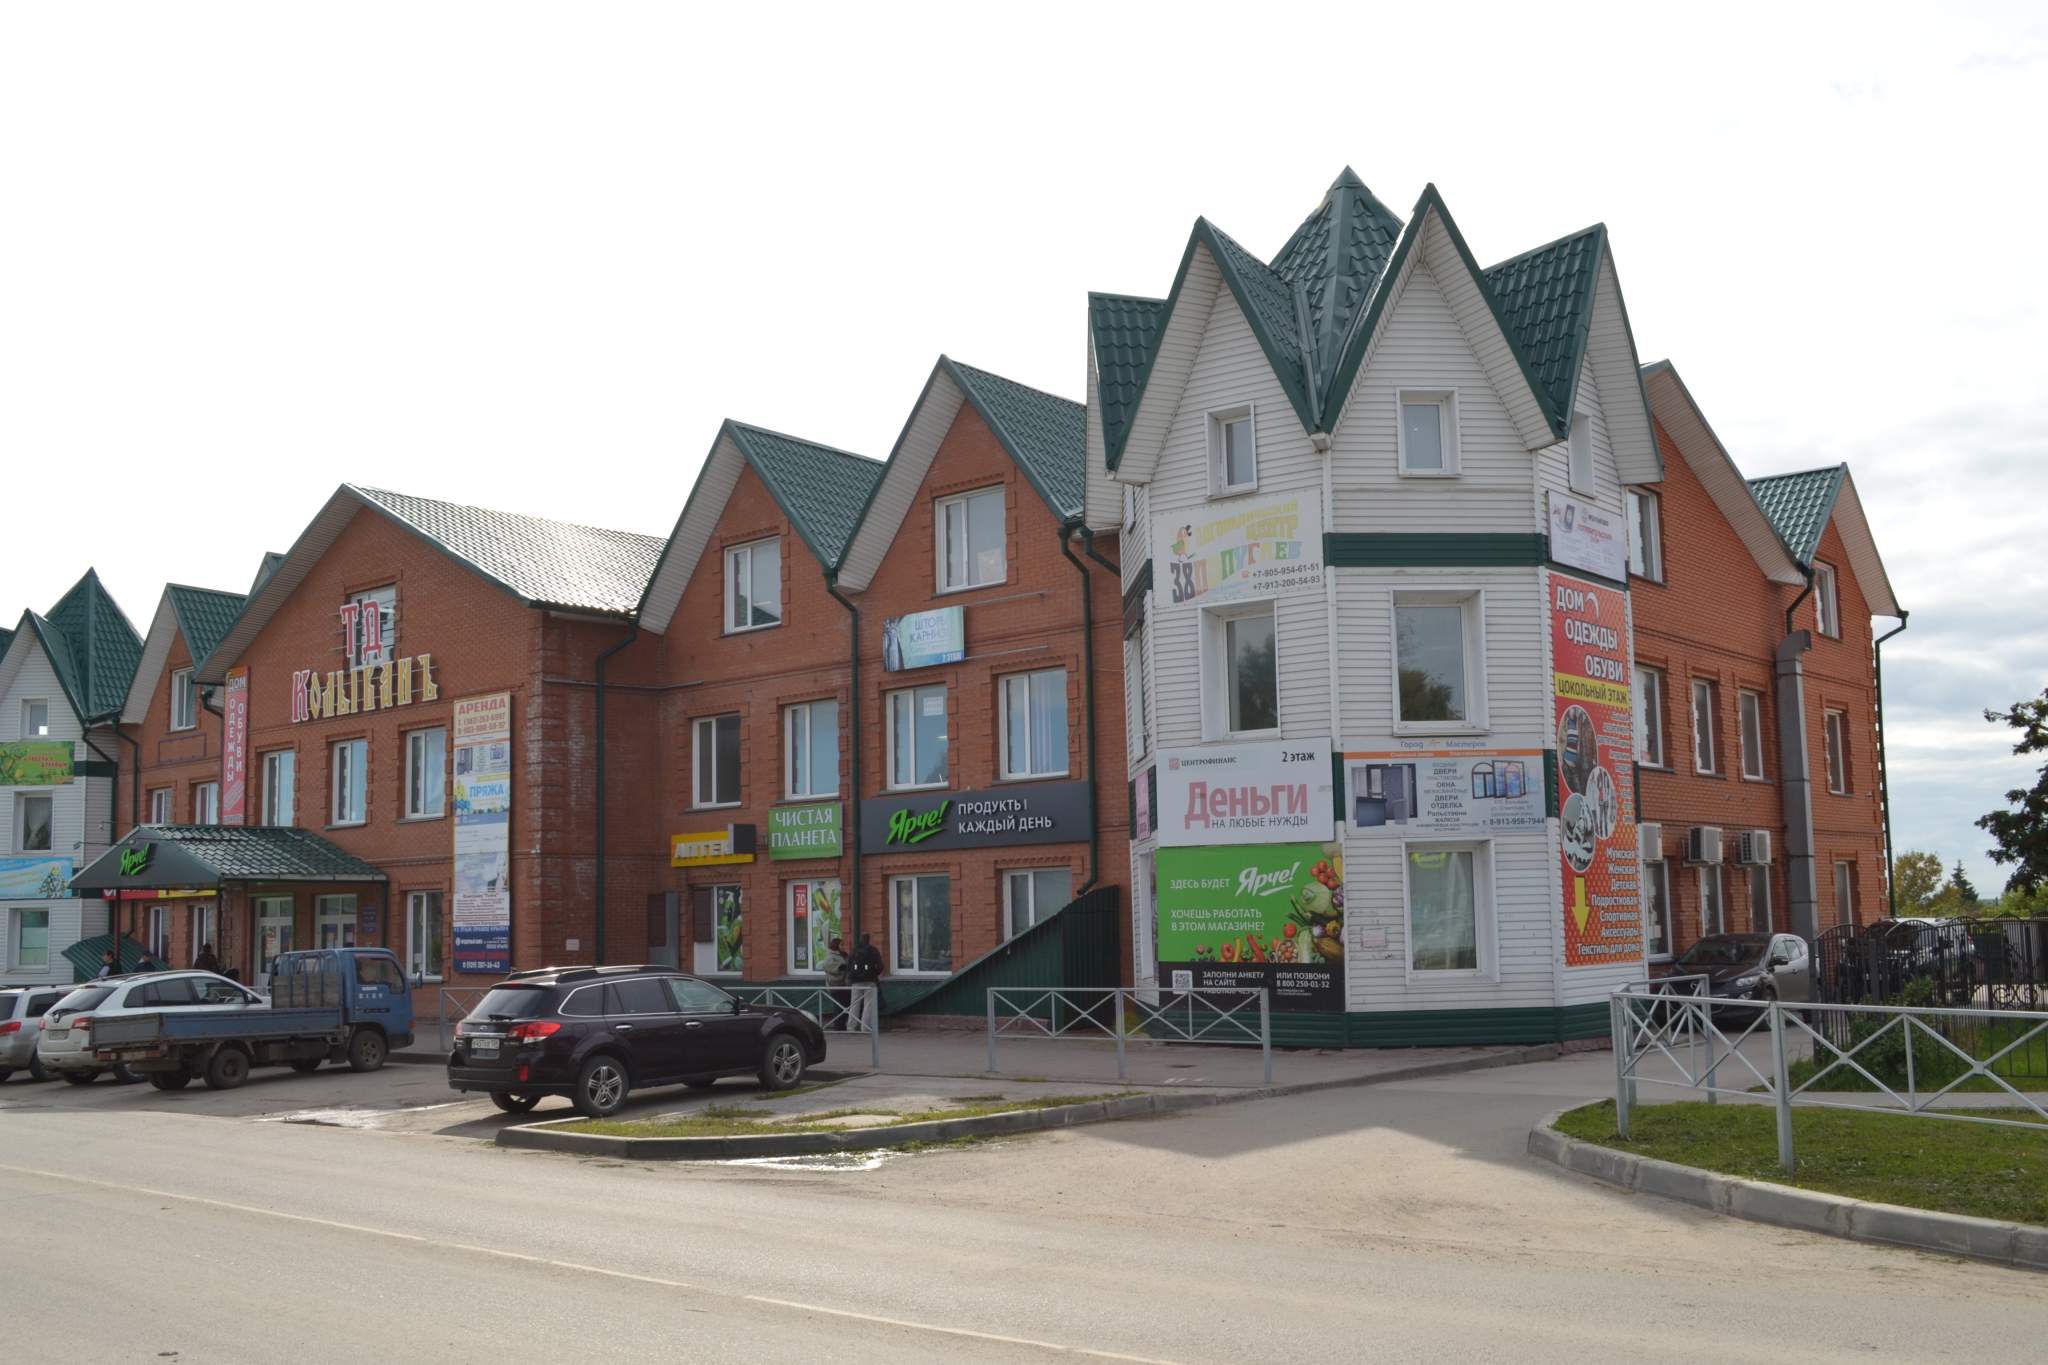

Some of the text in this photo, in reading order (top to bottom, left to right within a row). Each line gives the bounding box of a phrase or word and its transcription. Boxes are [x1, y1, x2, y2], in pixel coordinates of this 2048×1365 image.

[1556, 585, 1585, 613] ДОМ
[339, 600, 384, 663] ТД
[1564, 618, 1618, 653] ОДЕЖДЫ
[1584, 654, 1624, 683] ОБУВИ
[227, 676, 246, 693] ДОМ
[1558, 678, 1629, 704] ЦОКОЛЬНЫЙ ЭТАЖ
[458, 697, 506, 715] АРЕНДА
[1181, 756, 1237, 767] ЦЕНТРОФИНАНС
[1282, 751, 1316, 763] 2 этаж
[470, 783, 505, 798] ПРЯЖА
[1434, 794, 1458, 802] ДВЕРИ
[958, 799, 1028, 815] ПРОДУКТЫ
[1184, 781, 1308, 831] Деньги
[1431, 802, 1464, 810] ОТДЕЛКА
[775, 808, 833, 827] ЧИСТАЯ
[886, 800, 950, 845] Ярче!
[958, 815, 1053, 834] КАЖДЫЙ ДЕНЬ
[1212, 815, 1309, 829] НА ЛЮБЫЕ НУЖДЫ
[771, 827, 837, 848] ПЛАНЕТА
[120, 842, 150, 875] Ярче!
[1170, 879, 1231, 890] ЗДЕСЬ БУДЕТ
[1235, 861, 1301, 897] Ярче!
[1171, 908, 1262, 919] ХОЧЕШЬ РАБОТАТЬ
[1171, 920, 1265, 931] В ЭТОМ МАГАЗИНЕ?
[1577, 943, 1609, 955] Текстиль
[1238, 971, 1264, 979] АНКЕТУ
[1276, 972, 1293, 980] ИЛИ
